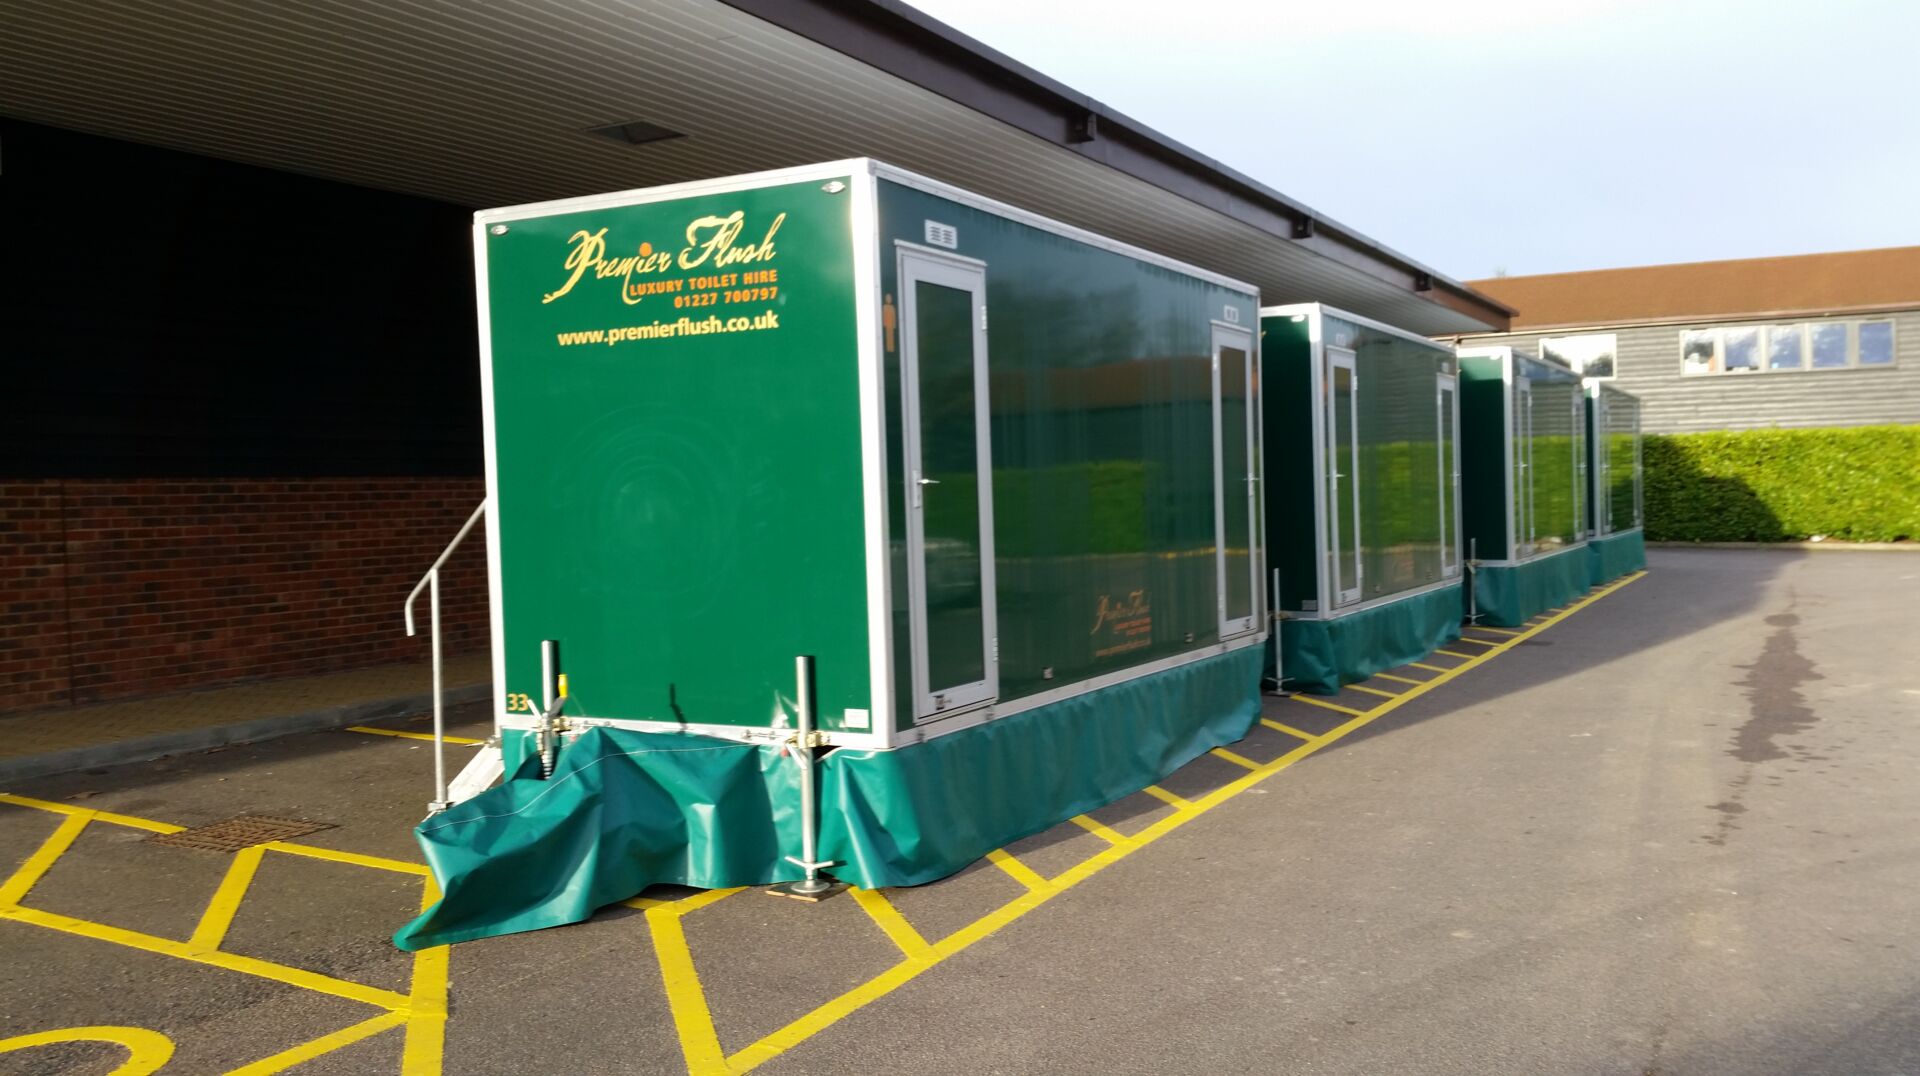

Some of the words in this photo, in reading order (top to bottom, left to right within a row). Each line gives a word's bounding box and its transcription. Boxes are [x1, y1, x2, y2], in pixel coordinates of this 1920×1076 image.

[542, 227, 672, 304] Premier
[678, 210, 786, 269] Flush
[629, 279, 683, 297] LUXURY
[689, 273, 737, 290] TOILET
[743, 269, 778, 284] HIRE
[673, 293, 717, 308] 01227
[724, 287, 778, 304] 700797
[557, 310, 779, 346] www.premierflush.co.uk
[507, 694, 528, 711] 33
